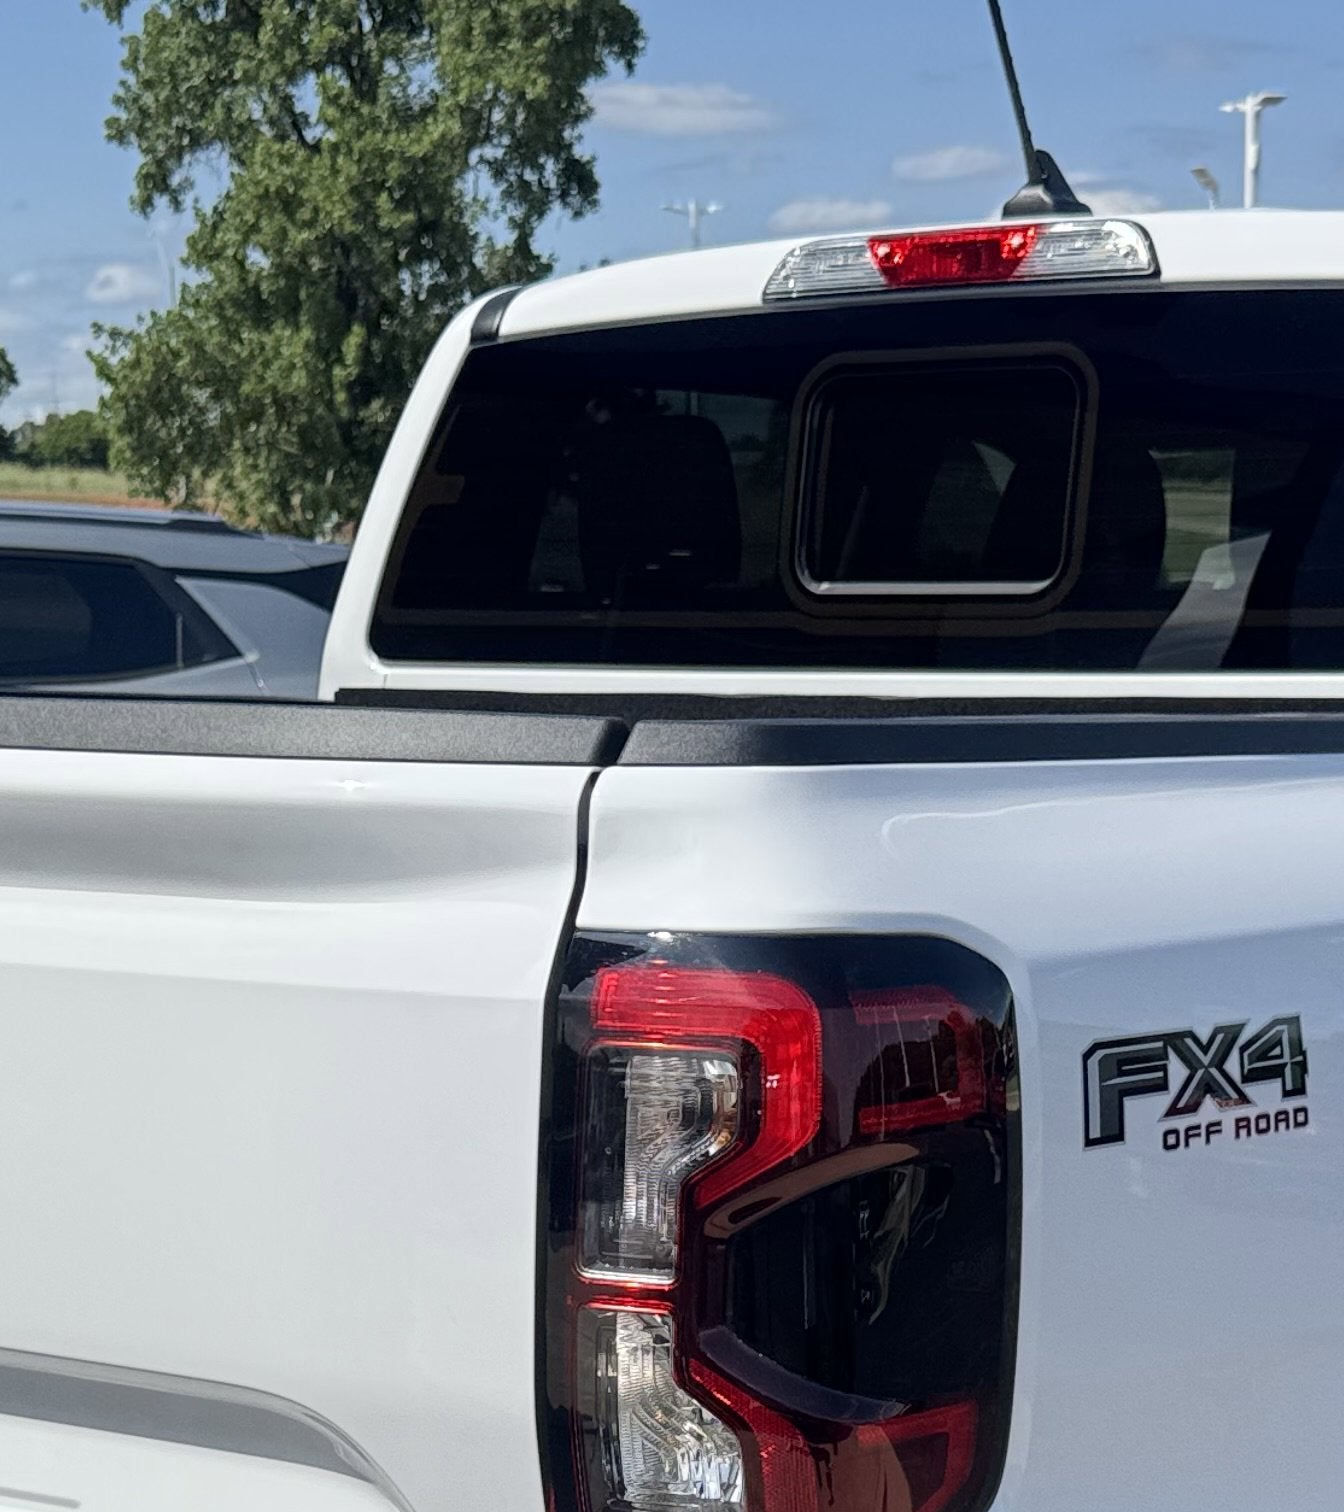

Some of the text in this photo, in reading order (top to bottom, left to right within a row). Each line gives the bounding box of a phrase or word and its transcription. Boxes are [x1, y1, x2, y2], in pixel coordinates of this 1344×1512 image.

[1081, 1012, 1309, 1151] FX4
[1162, 1106, 1310, 1151] OFF ROAD
